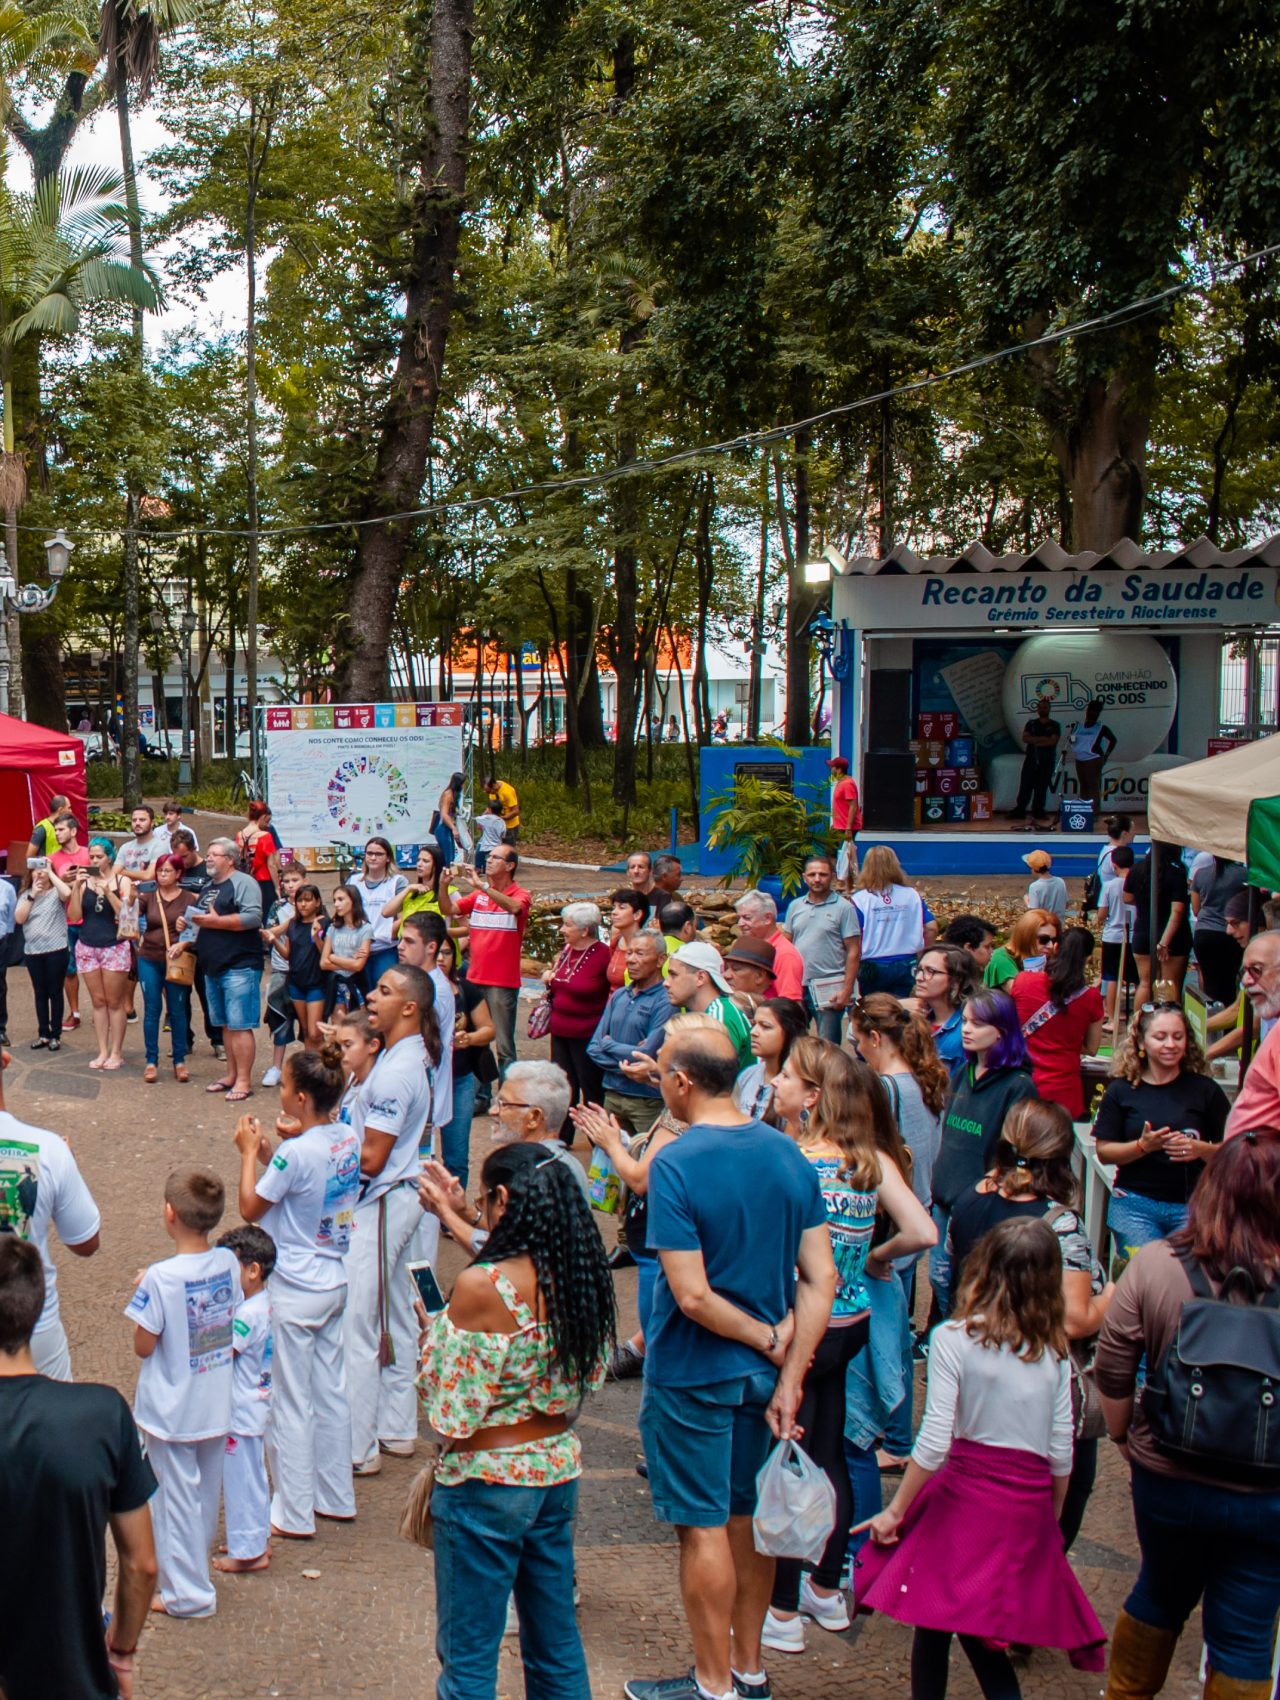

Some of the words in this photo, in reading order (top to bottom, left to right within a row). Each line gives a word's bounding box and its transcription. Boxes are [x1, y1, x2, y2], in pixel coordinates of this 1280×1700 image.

[922, 576, 1047, 605] Recanto
[1065, 575, 1102, 603] da
[1121, 573, 1264, 601] Saudade
[988, 607, 1038, 621] Grêmio
[1045, 606, 1125, 620] Seresteiro
[1131, 604, 1217, 619] Rioclarense
[1095, 669, 1151, 682] CAMINHÃO
[1095, 681, 1167, 693] CONHECENDO
[1118, 692, 1146, 704] ODS
